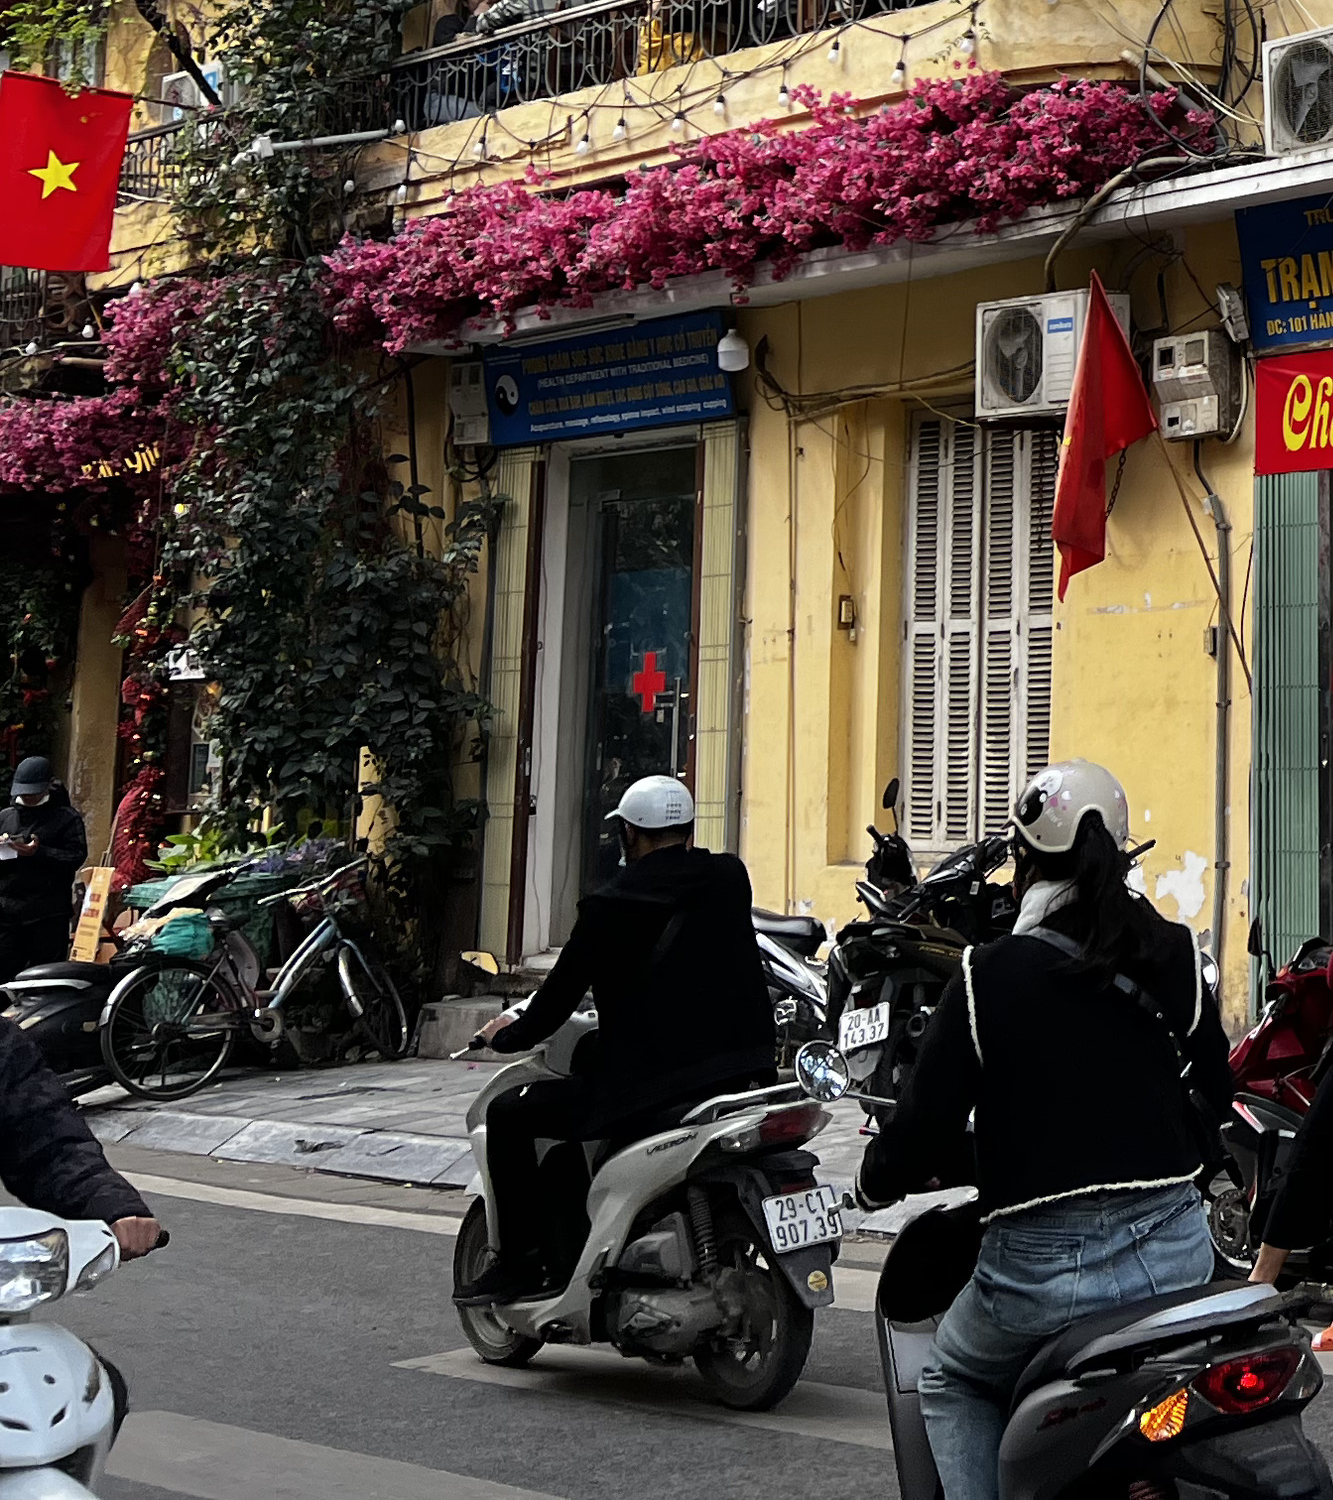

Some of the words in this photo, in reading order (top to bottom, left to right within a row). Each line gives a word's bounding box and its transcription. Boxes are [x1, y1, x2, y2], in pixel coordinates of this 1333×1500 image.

[1266, 319, 1287, 336] ĐC:
[1289, 316, 1308, 333] 101
[847, 1007, 882, 1031] 20-AA
[843, 1022, 885, 1048] 143.37
[776, 1190, 827, 1222] 29-C1
[776, 1213, 839, 1248] 907.39
